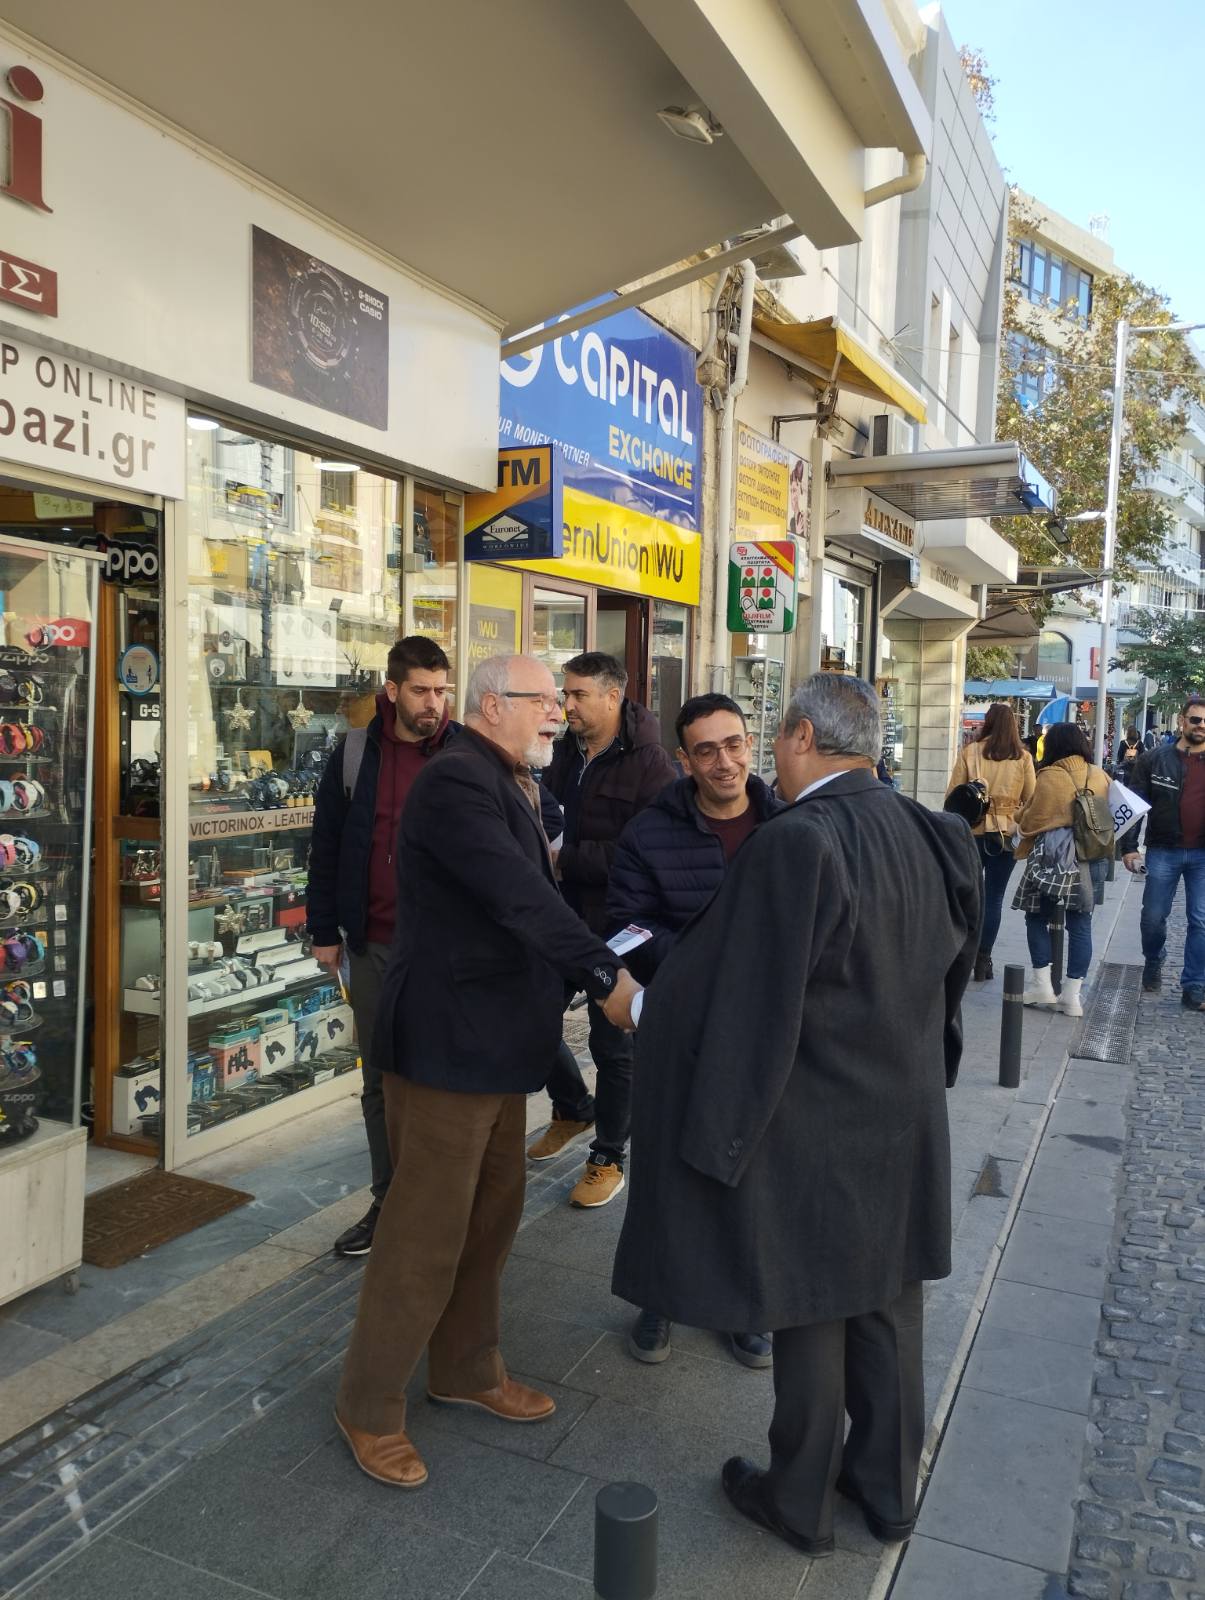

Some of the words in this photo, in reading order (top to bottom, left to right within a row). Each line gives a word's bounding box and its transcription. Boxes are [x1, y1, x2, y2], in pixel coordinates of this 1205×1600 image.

[358, 290, 384, 311] G-SHOCK
[360, 302, 383, 320] CASIO
[35, 355, 157, 420] ONLINE
[490, 525, 521, 533] Euronet
[190, 816, 264, 836] VICTORINOX
